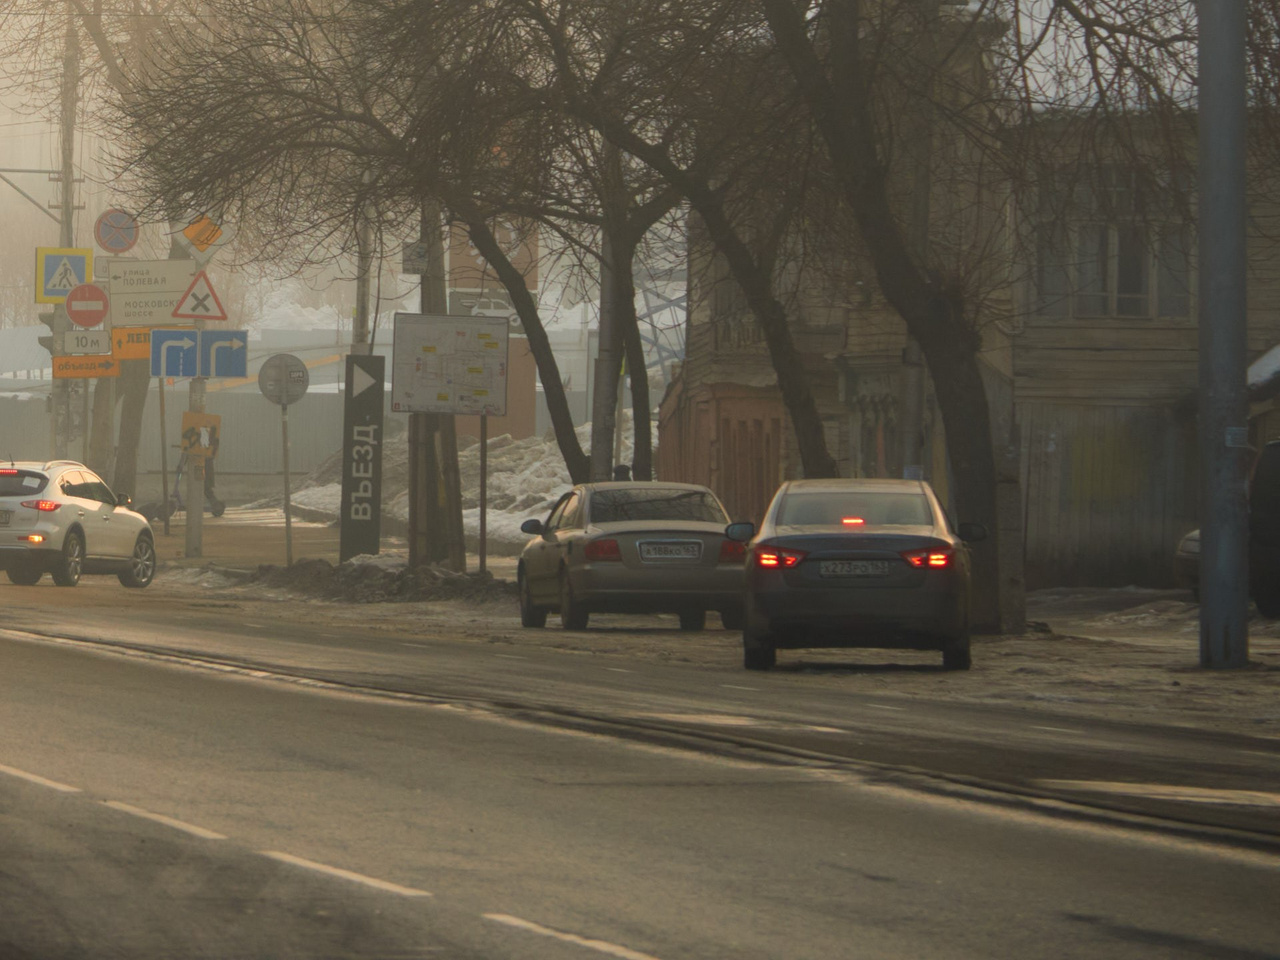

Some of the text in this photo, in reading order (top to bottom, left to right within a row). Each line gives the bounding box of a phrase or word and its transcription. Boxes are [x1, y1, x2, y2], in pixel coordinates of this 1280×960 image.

[123, 269, 150, 277] улица
[123, 277, 167, 286] ПОЛЕВАЯ
[75, 335, 88, 348] 10
[351, 424, 378, 521] ВЪЕЗД
